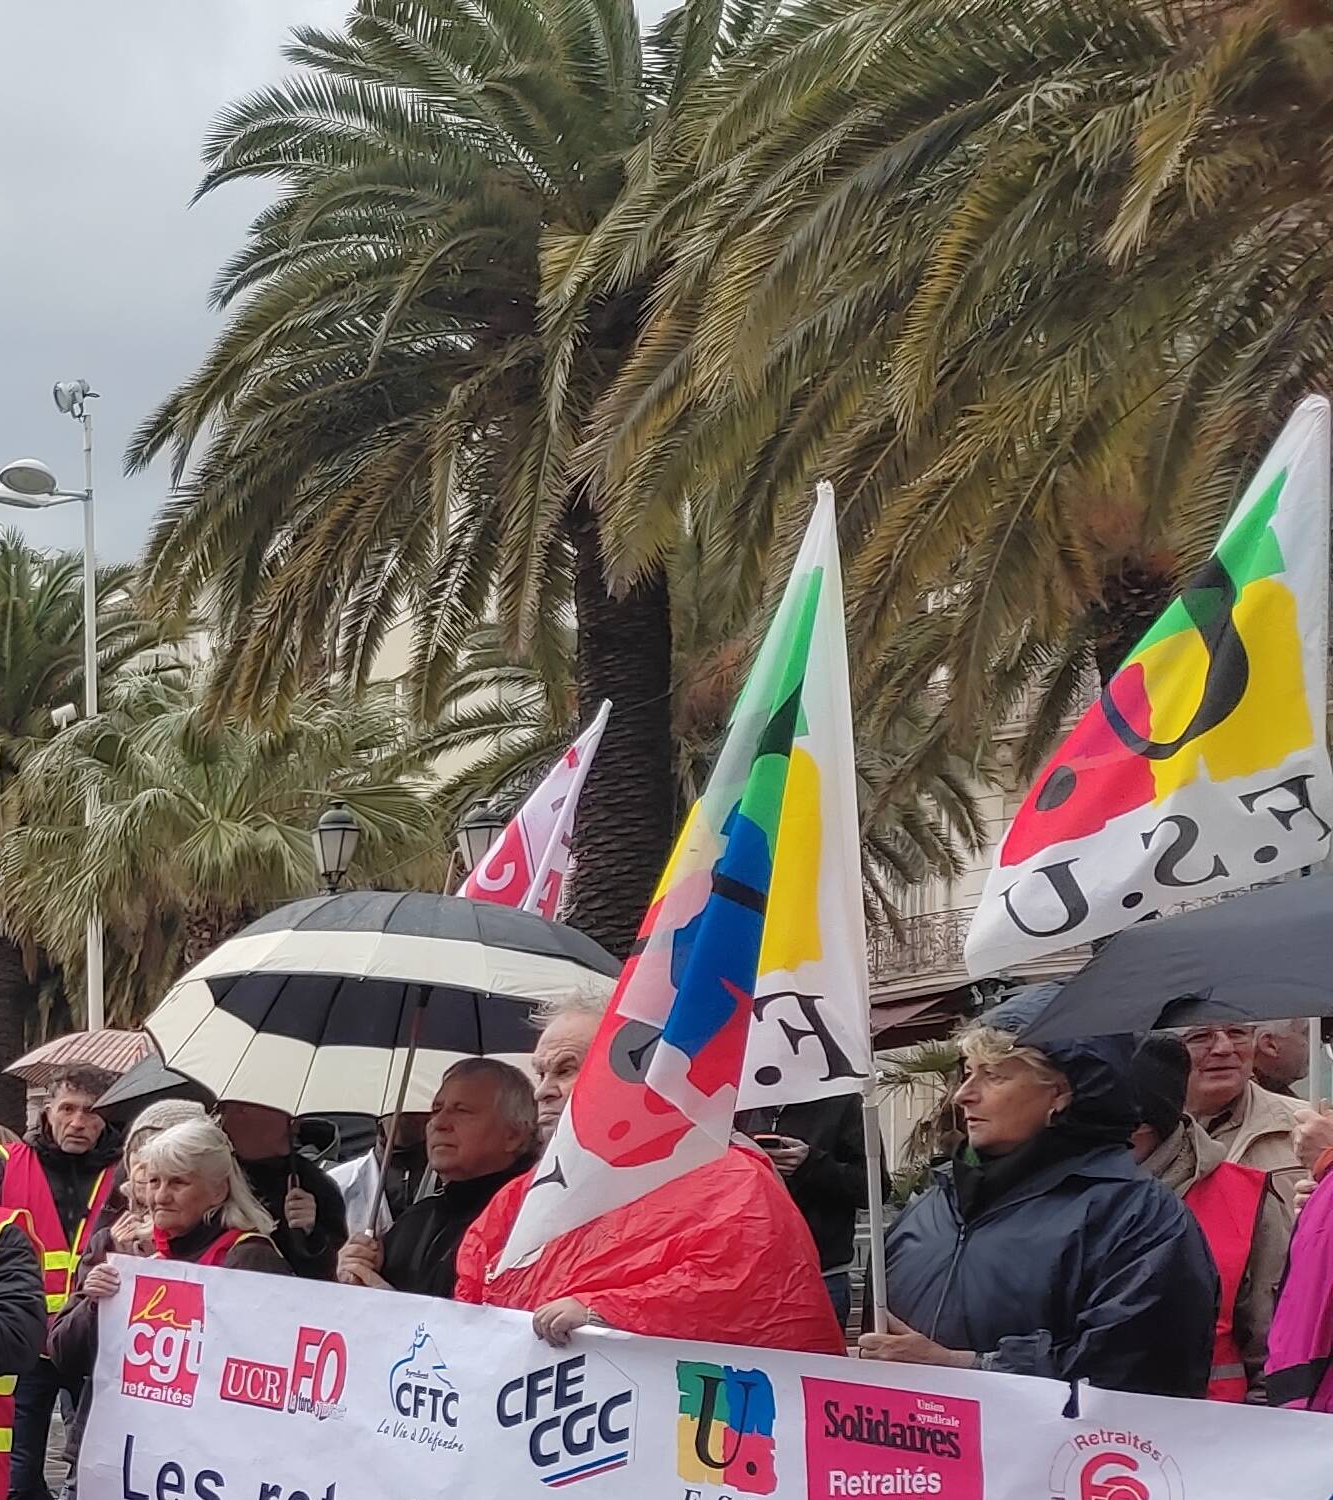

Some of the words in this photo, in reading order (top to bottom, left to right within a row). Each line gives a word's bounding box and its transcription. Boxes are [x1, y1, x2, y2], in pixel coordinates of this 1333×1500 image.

[132, 1285, 199, 1328] la
[127, 1319, 204, 1383] cgt
[290, 1326, 347, 1408] FO
[123, 1380, 193, 1406] retraités
[226, 1361, 281, 1403] UCR
[497, 1354, 586, 1428] CFE
[395, 1382, 460, 1428] CFTC
[915, 1412, 961, 1428] syndicale
[916, 1399, 946, 1414] Union
[376, 1418, 390, 1435] La
[393, 1420, 408, 1439] Vie
[417, 1426, 464, 1452] Défendre
[529, 1388, 633, 1468] CGC
[824, 1400, 962, 1460] Solidaires
[1073, 1428, 1163, 1462] Retraités
[828, 1466, 943, 1497] Retraités
